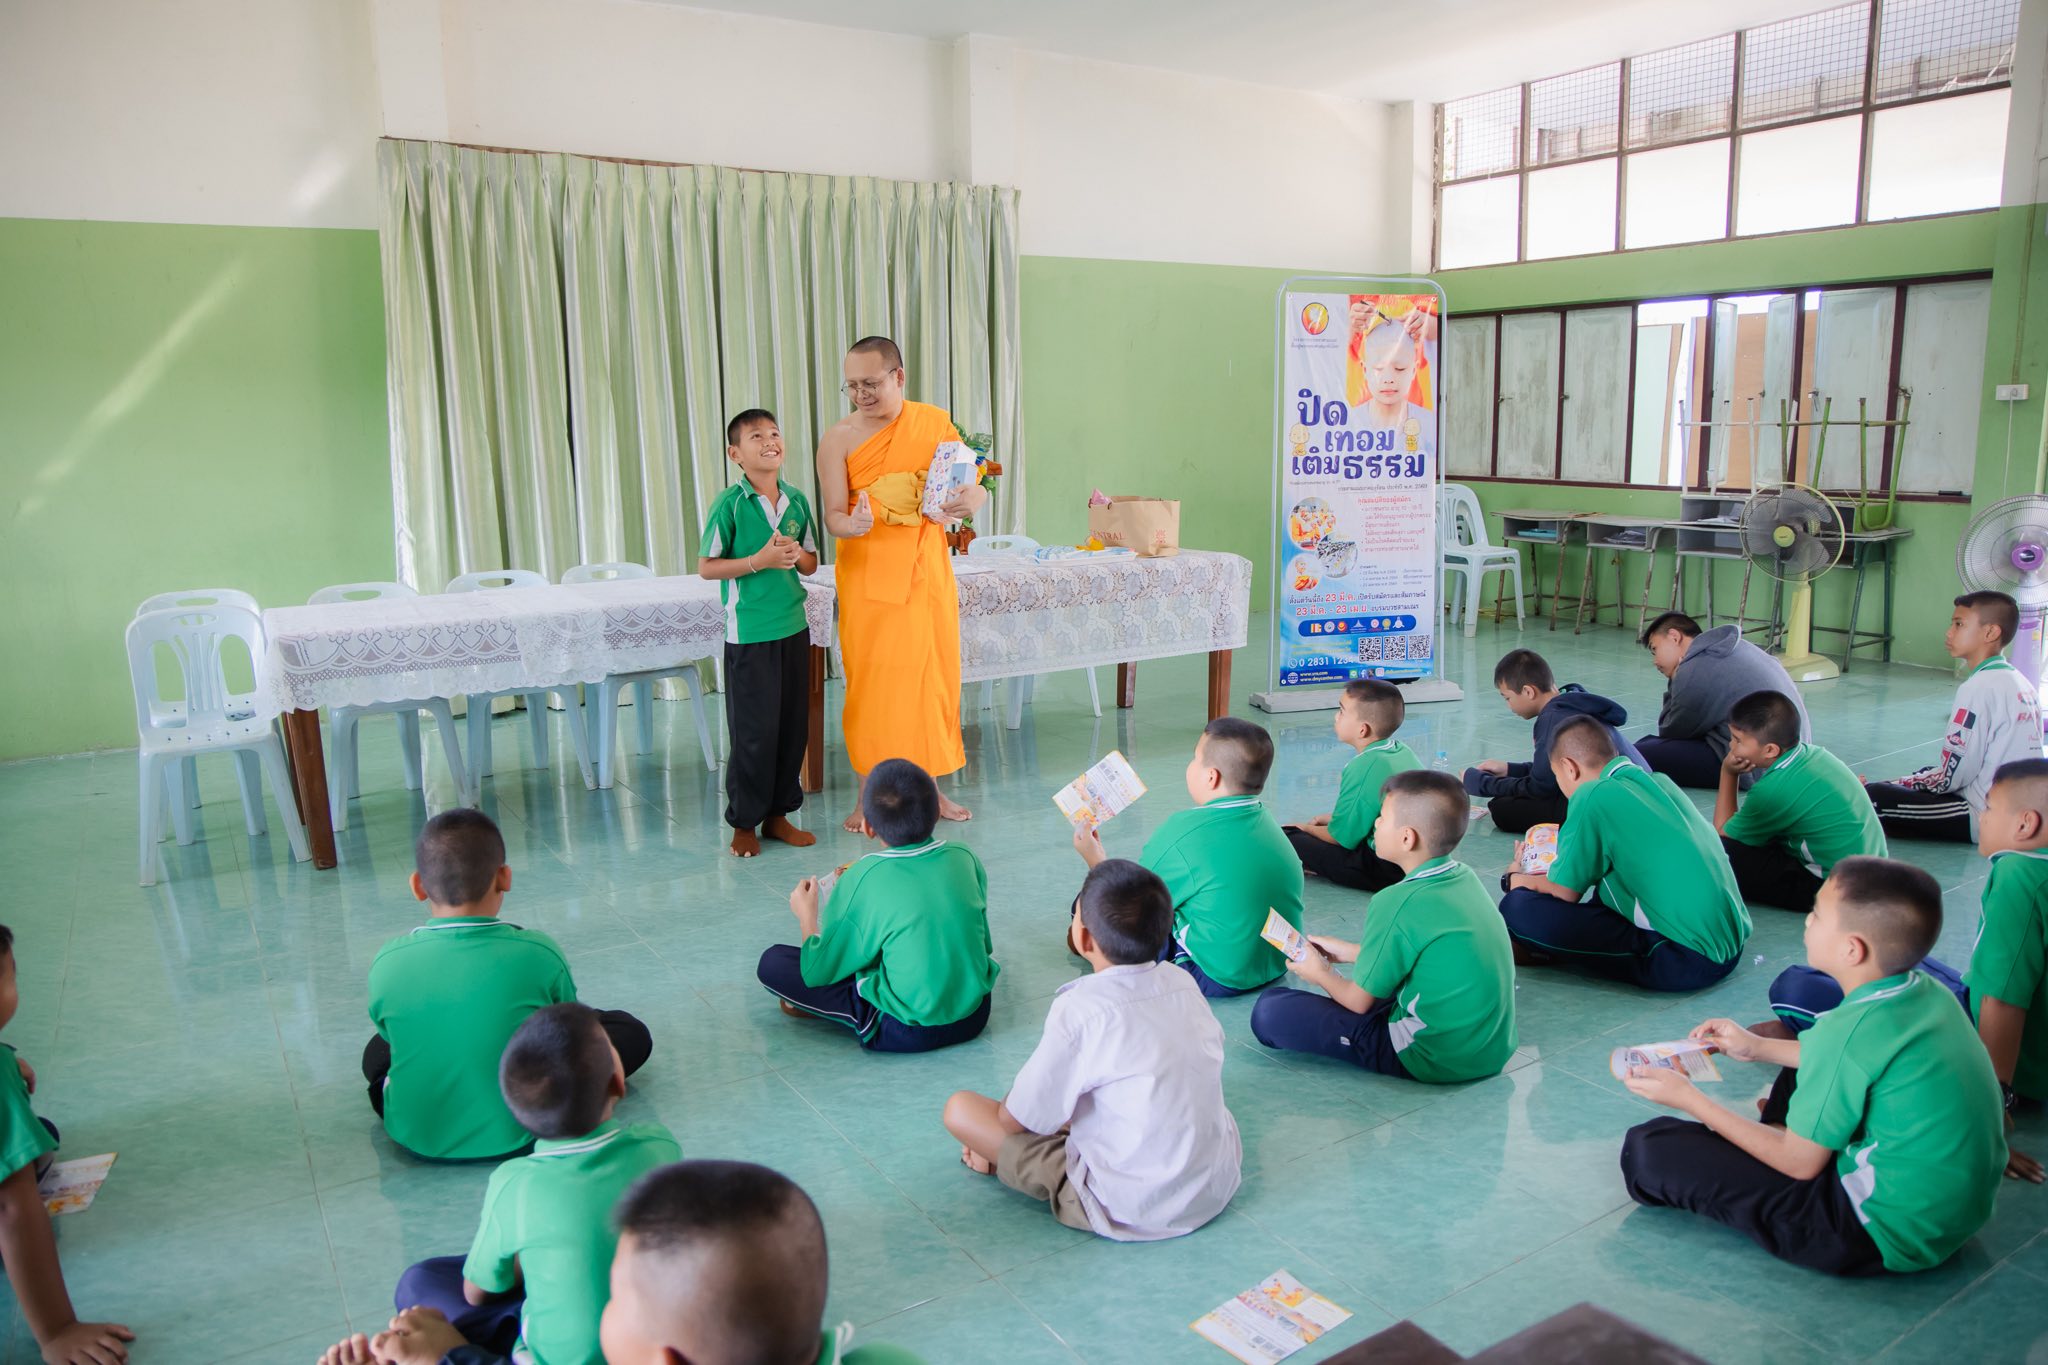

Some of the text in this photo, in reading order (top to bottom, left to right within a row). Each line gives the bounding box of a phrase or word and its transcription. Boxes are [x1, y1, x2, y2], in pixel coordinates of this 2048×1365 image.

[1297, 388, 1348, 427] ปิด
[1325, 429, 1395, 452] เทอม
[1325, 593, 1337, 602] 23
[1339, 591, 1356, 601] มี.ค.
[1296, 607, 1308, 616] 23
[1310, 604, 1327, 615] มี.ค.
[1336, 605, 1347, 614] 23
[1299, 658, 1305, 667] 0
[1307, 656, 1329, 667] 2831
